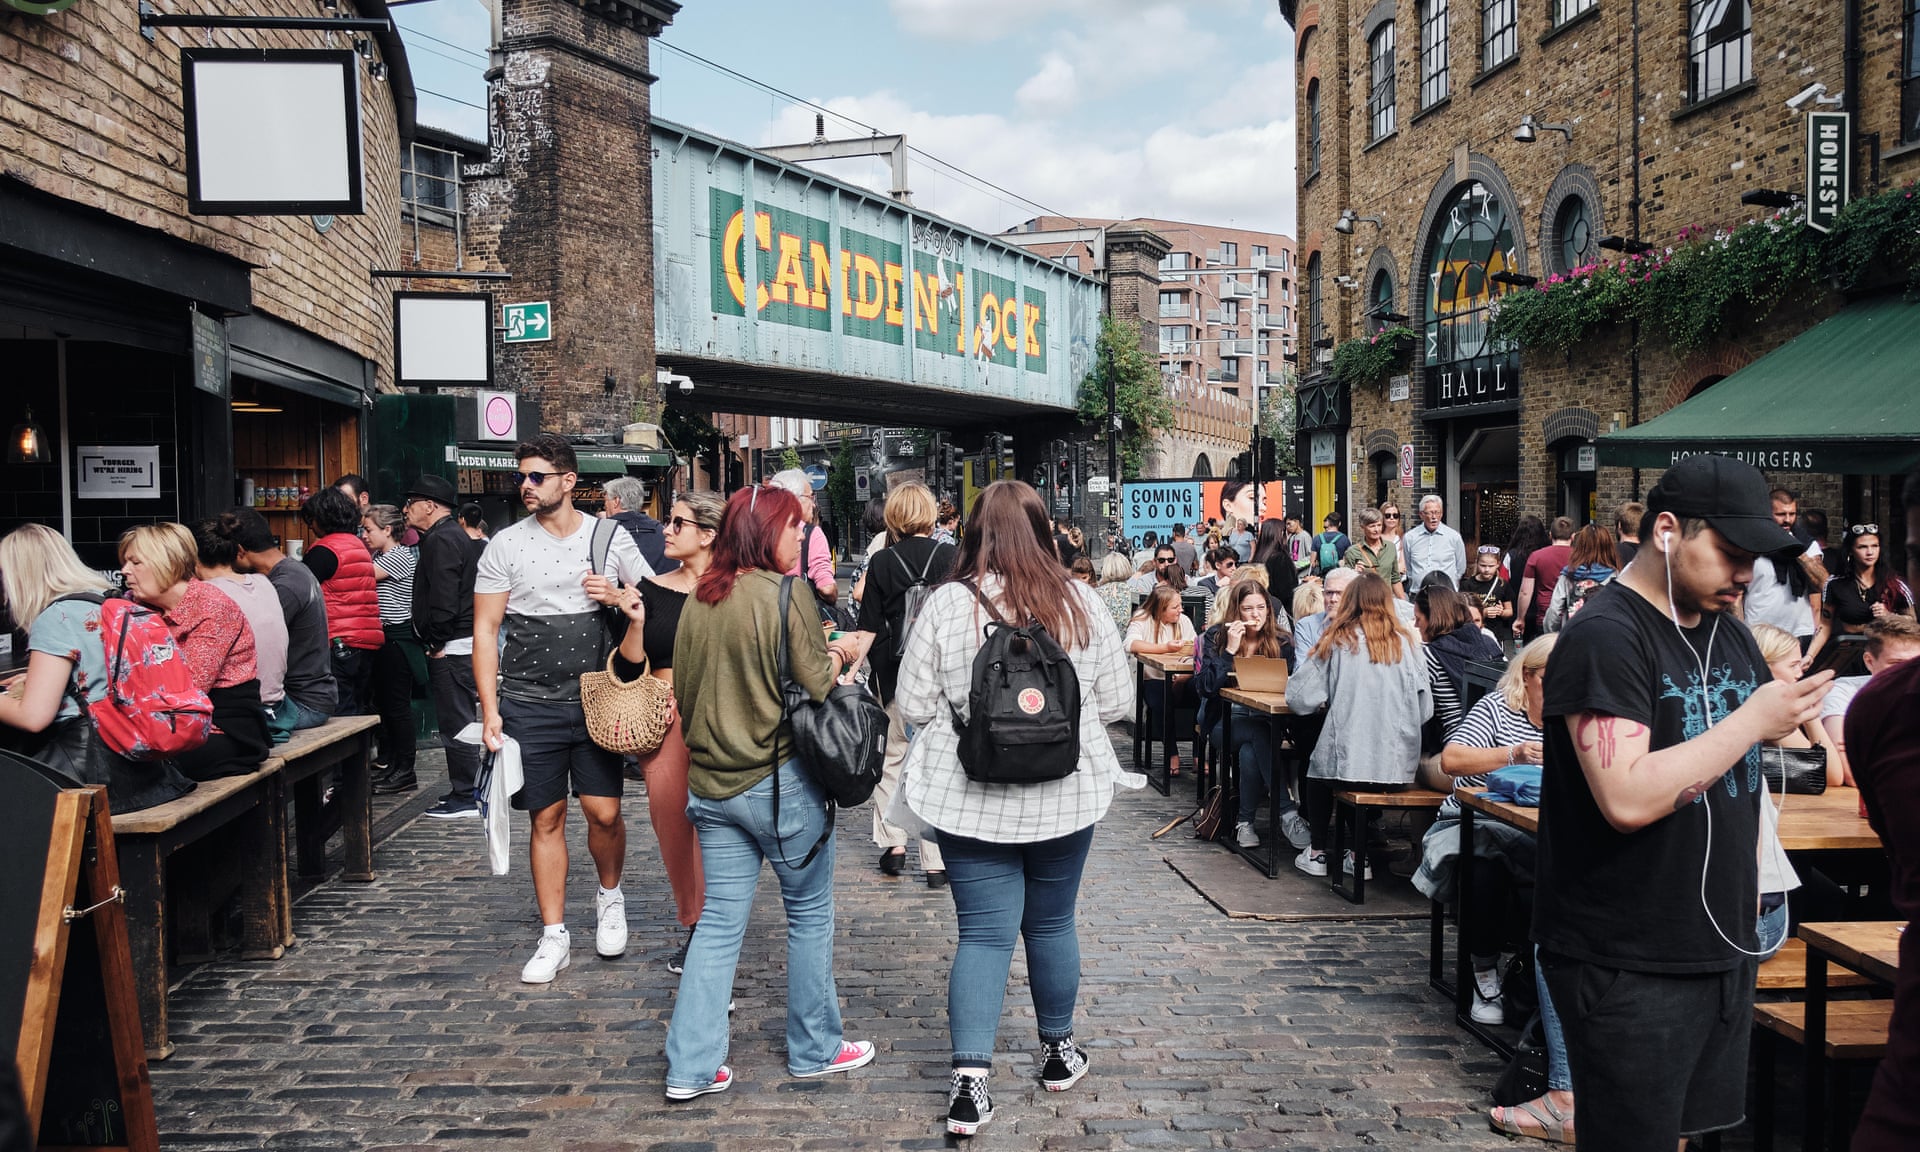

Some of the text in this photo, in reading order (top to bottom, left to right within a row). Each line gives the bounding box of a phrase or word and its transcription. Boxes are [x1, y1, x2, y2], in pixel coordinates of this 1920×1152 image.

[1819, 124, 1839, 217] HONEST
[722, 208, 1041, 358] CAMDEN LOCK
[1441, 364, 1506, 399] HALL
[456, 456, 519, 468] AMDEN MARKE
[1670, 450, 1813, 468] HOT BURGERS
[1131, 489, 1192, 503] COMING
[1131, 504, 1192, 519] SOON
